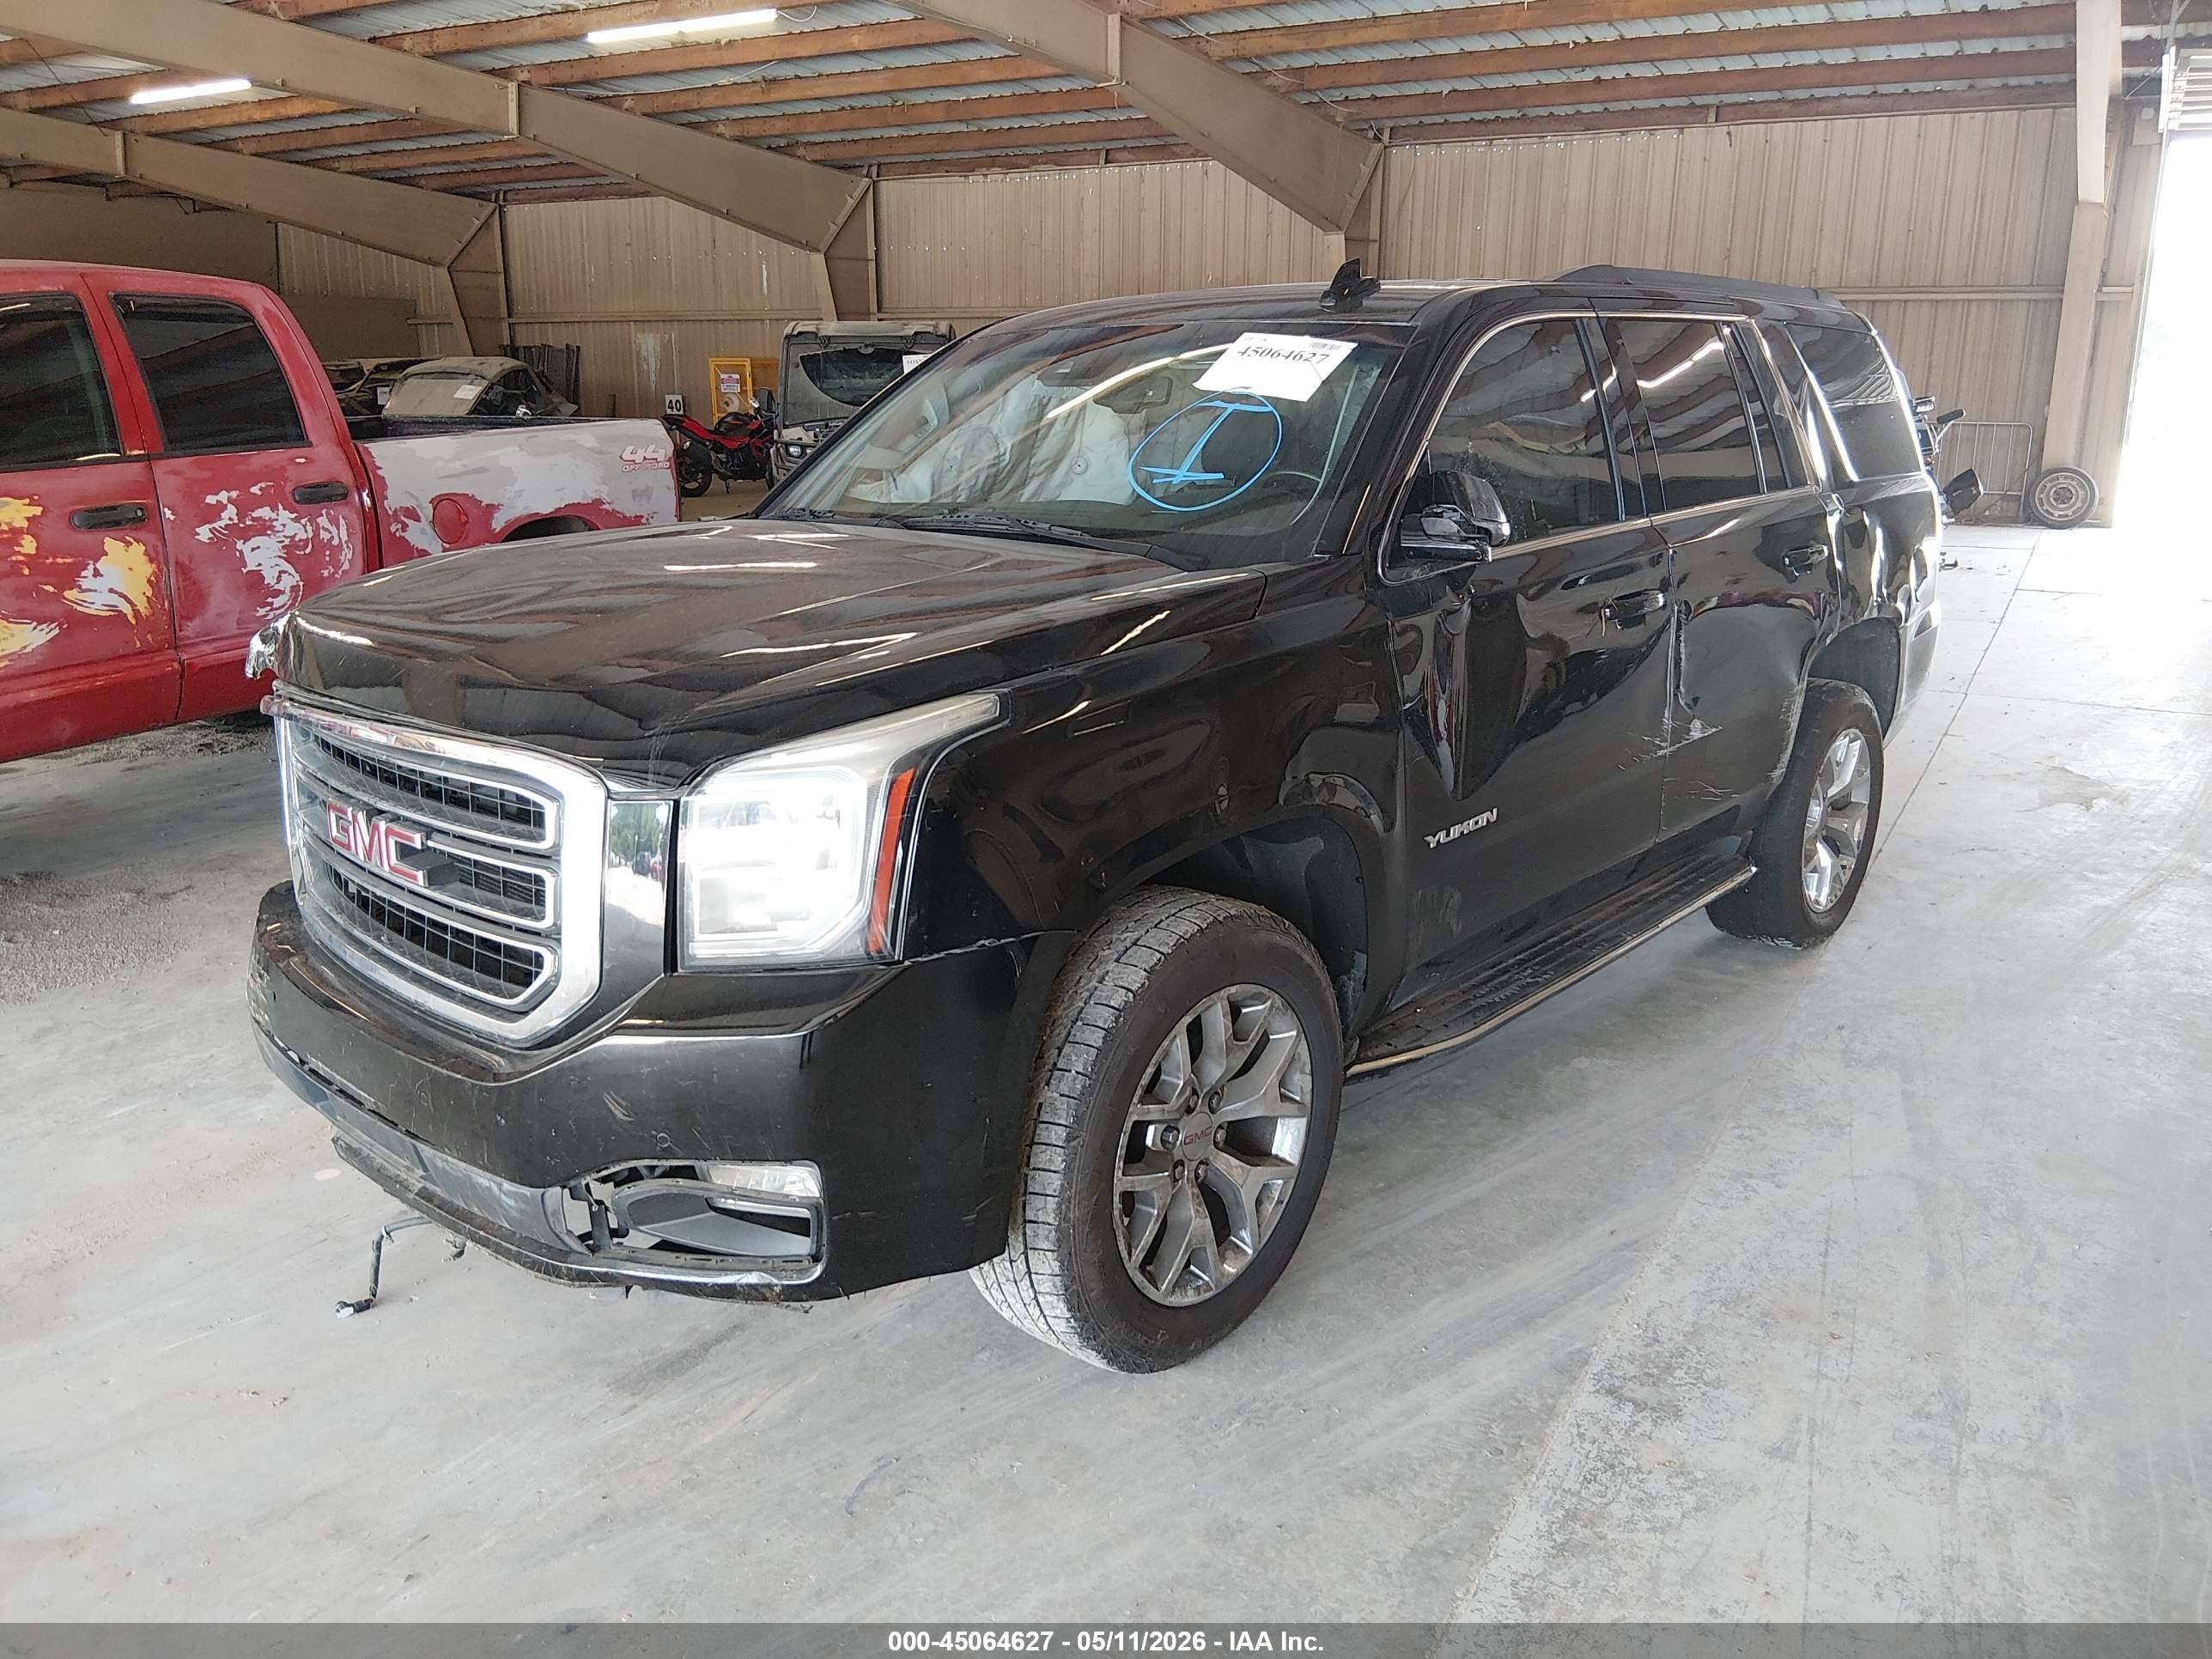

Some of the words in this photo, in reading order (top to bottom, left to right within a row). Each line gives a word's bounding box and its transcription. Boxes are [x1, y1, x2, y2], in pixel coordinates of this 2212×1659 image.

[1237, 345, 1330, 365] 45064627
[667, 398, 682, 413] 40
[1423, 806, 1498, 849] YUKON
[326, 797, 429, 887] GMC
[1183, 1126, 1213, 1146] GMC
